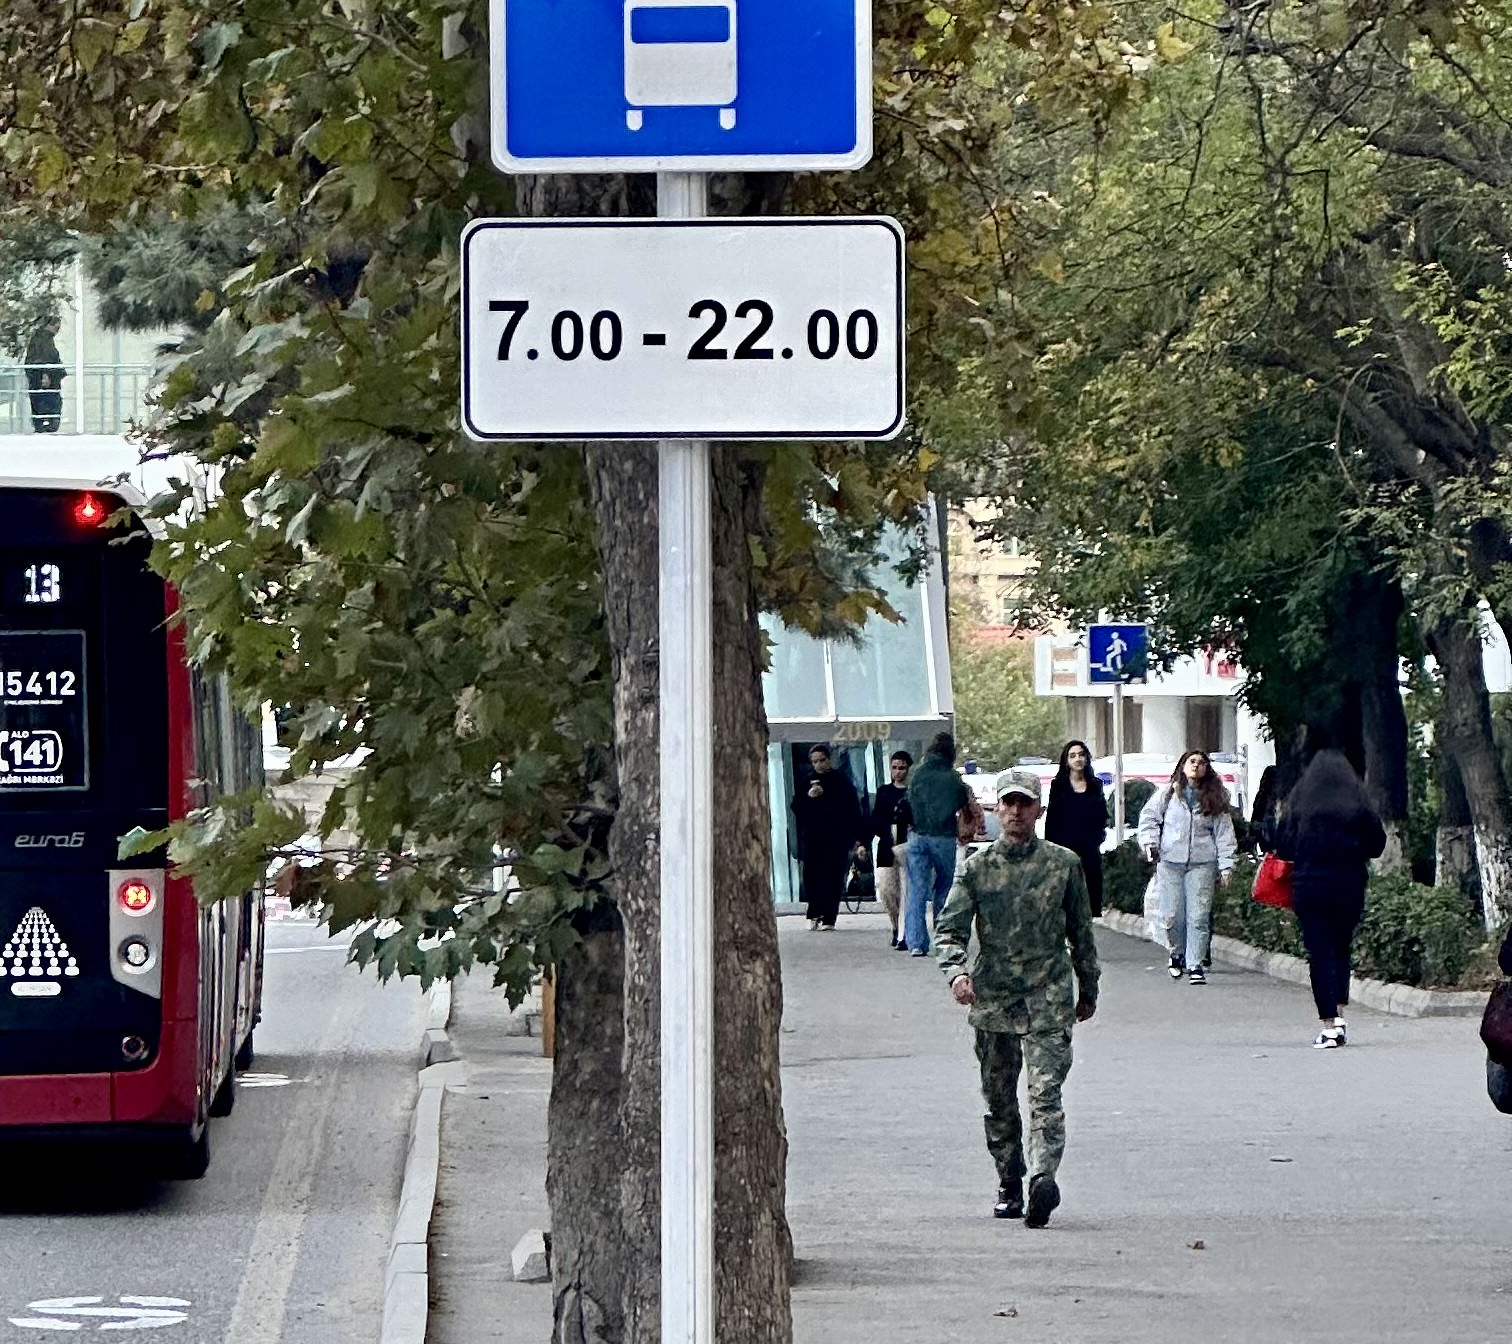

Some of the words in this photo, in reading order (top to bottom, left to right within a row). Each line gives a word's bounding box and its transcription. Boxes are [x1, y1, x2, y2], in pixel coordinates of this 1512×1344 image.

[487, 299, 623, 362] 7.00
[686, 298, 879, 361] 22.00
[24, 563, 61, 603] 13
[8, 739, 55, 766] 141
[14, 831, 86, 848] euro6
